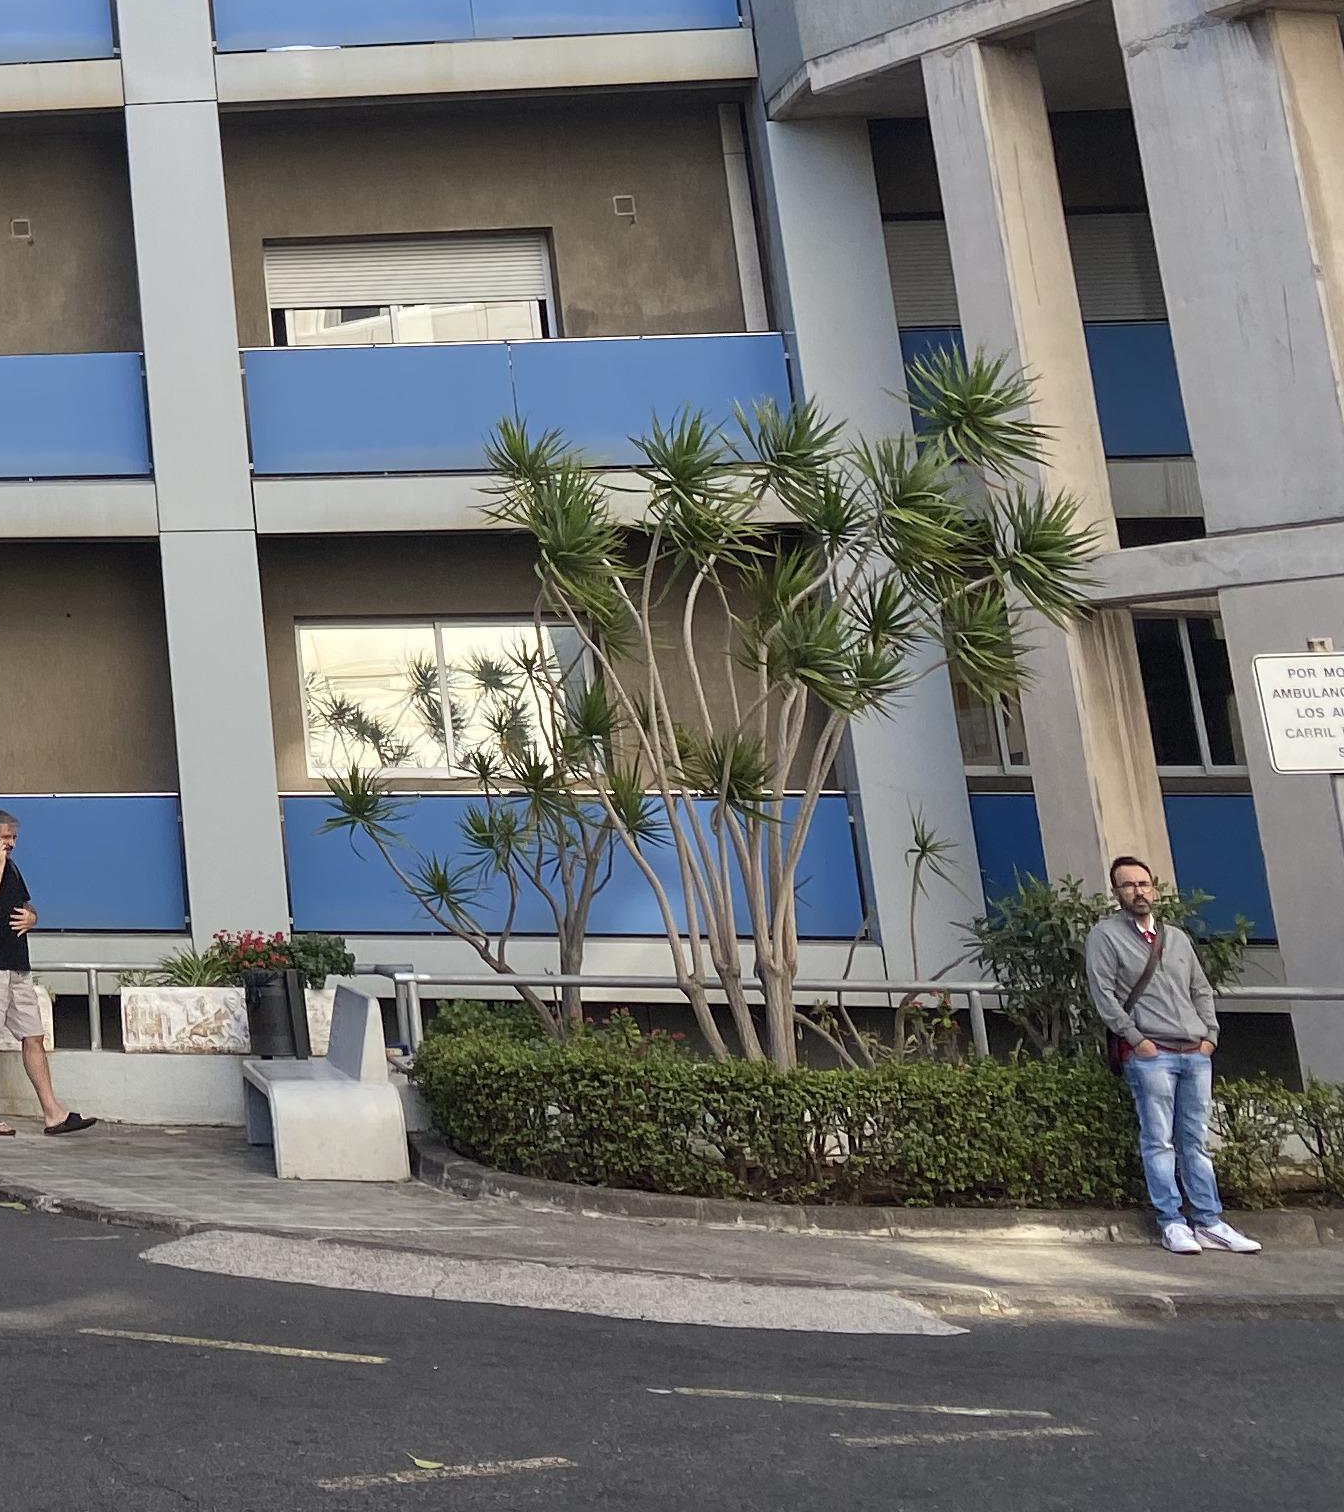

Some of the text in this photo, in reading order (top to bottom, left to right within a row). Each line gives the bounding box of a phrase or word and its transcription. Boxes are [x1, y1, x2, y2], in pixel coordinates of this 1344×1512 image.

[1287, 668, 1317, 679] POR
[1297, 707, 1325, 719] LOS
[1285, 728, 1336, 739] CARRIL
